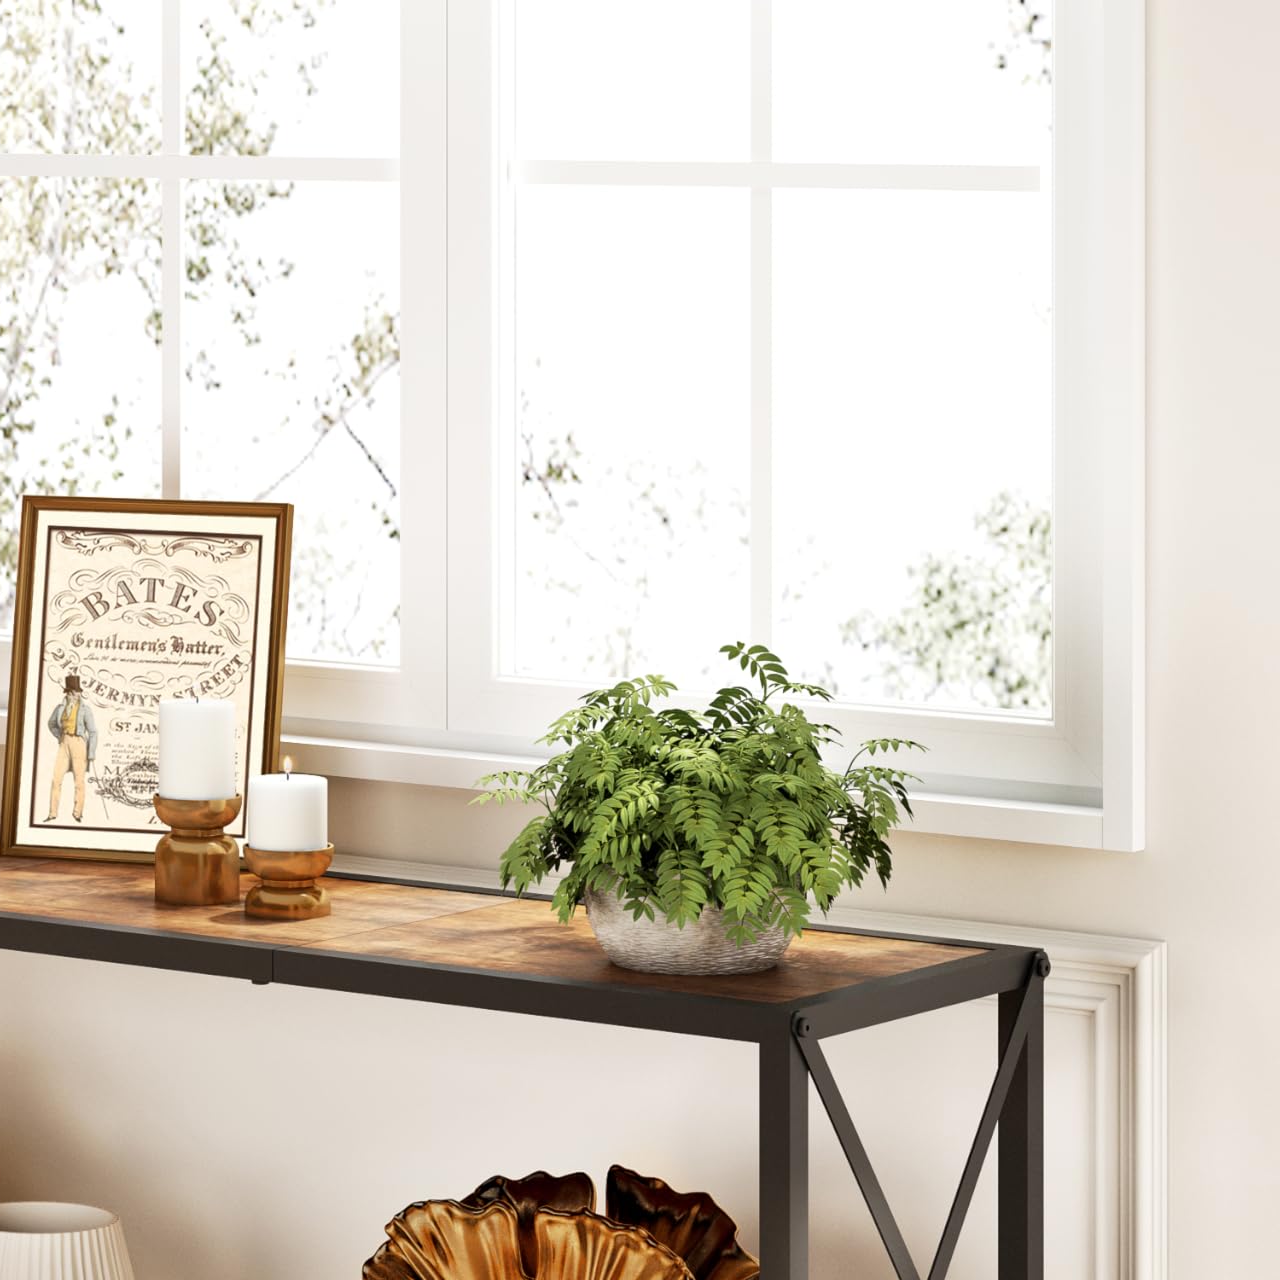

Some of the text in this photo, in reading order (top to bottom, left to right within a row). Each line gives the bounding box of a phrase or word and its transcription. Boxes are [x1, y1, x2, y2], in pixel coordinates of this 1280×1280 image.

[79, 577, 225, 627] BATES
[70, 631, 226, 657] Gentlemen's Hatter,
[81, 675, 161, 708] JERMYN
